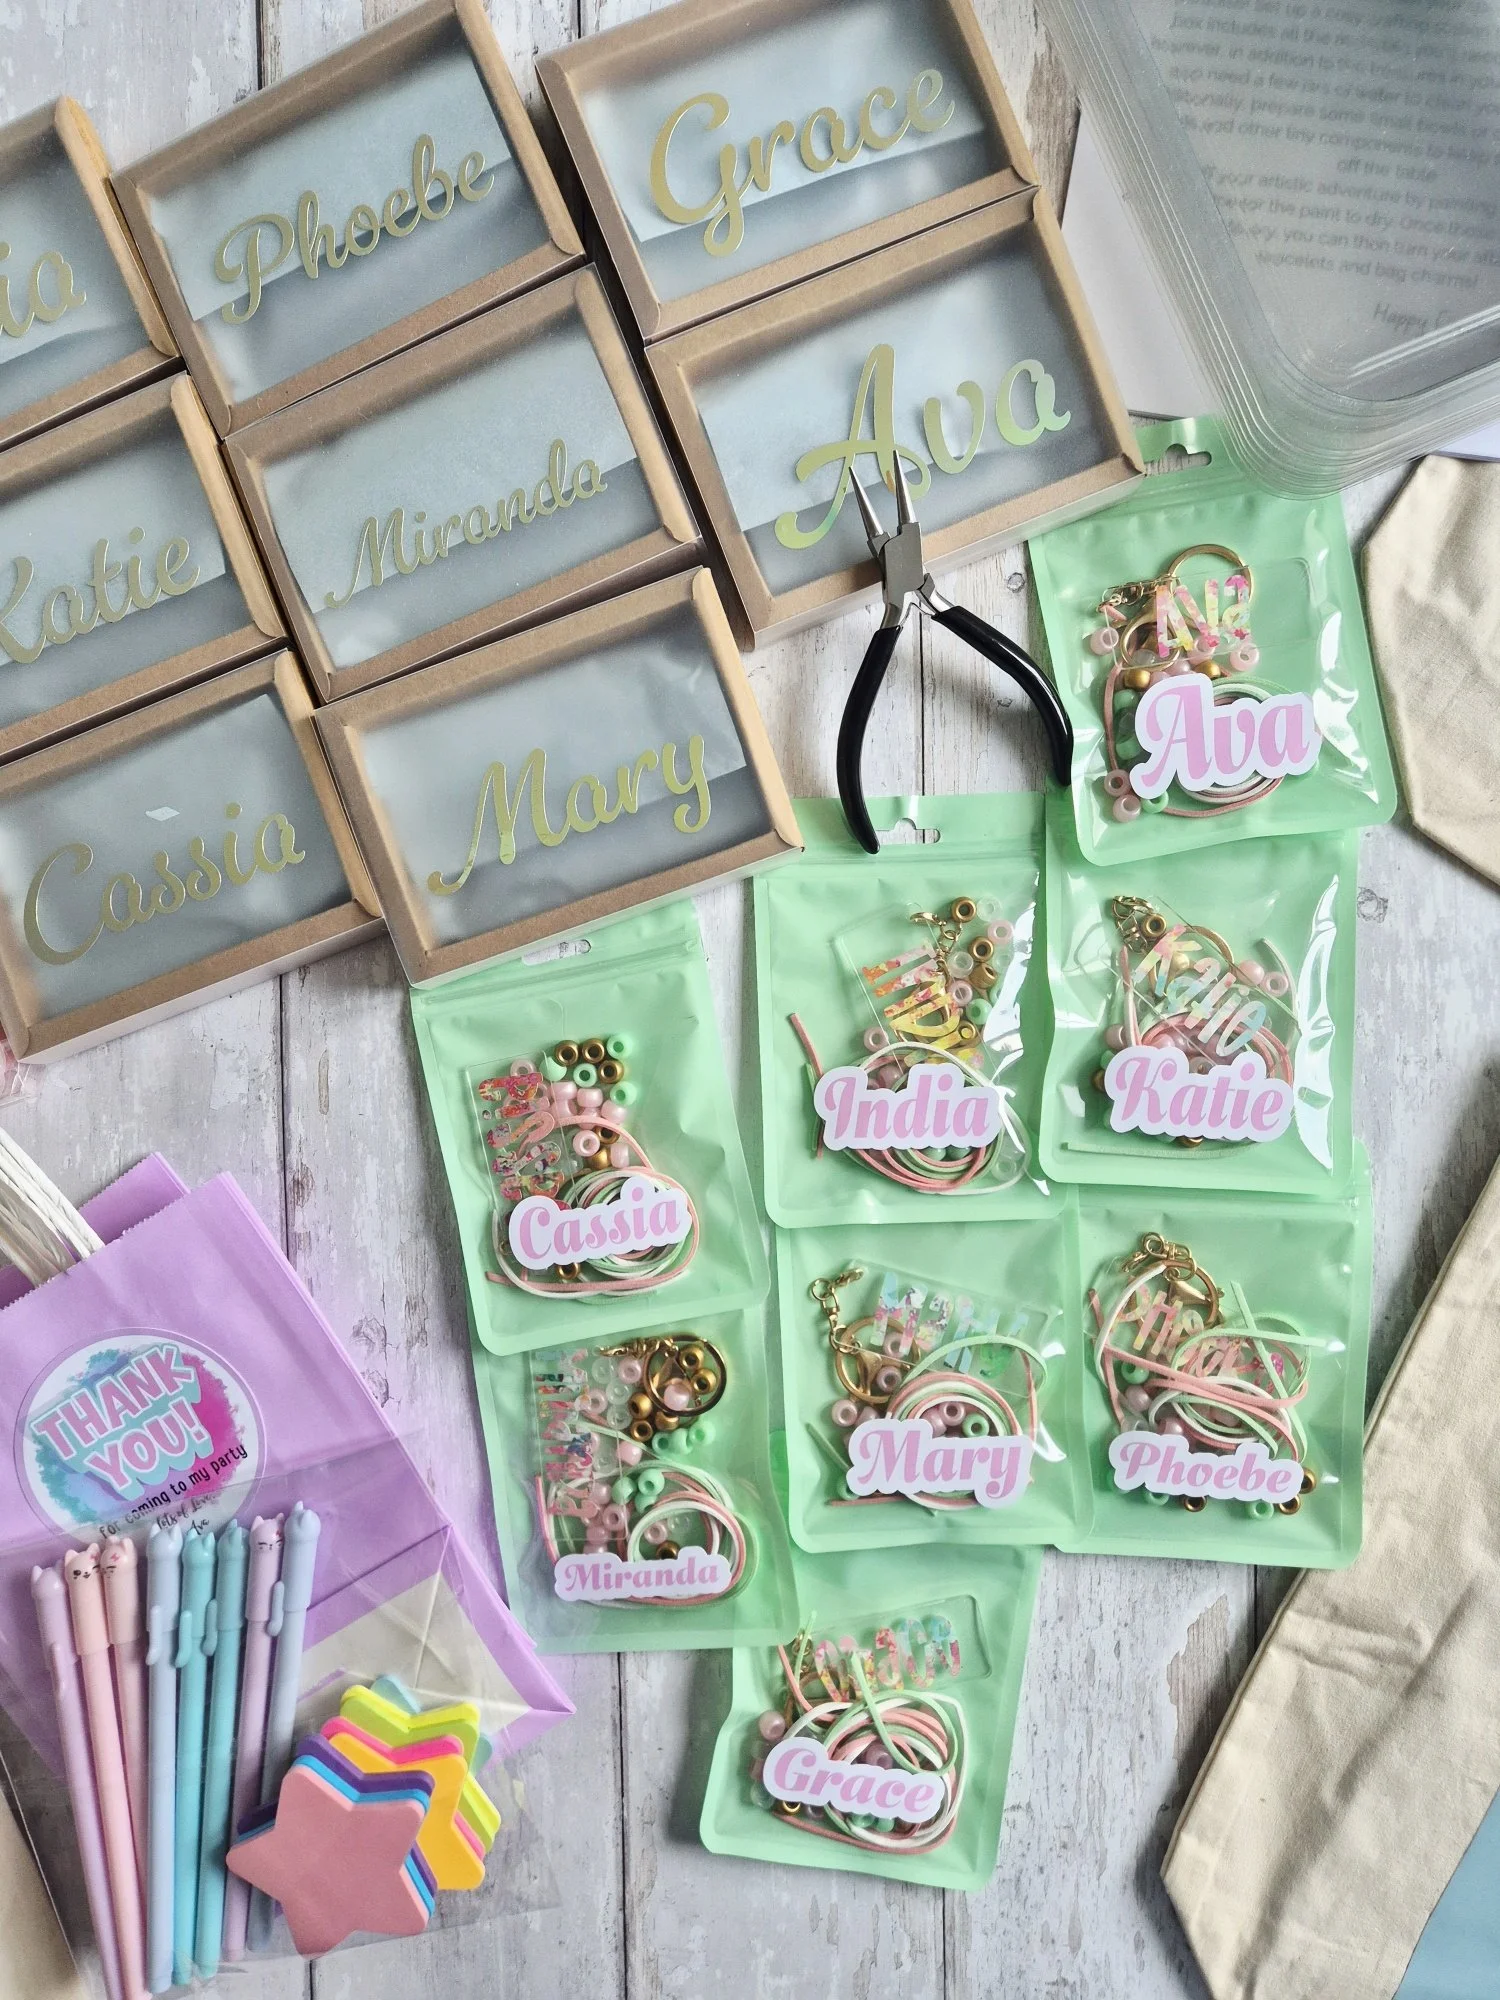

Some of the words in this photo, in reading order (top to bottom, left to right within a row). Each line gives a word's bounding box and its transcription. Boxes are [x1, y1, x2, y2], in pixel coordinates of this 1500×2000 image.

[649, 69, 956, 256] Grace
[214, 134, 495, 325] Phoebe
[774, 344, 1071, 549] Ava
[325, 437, 608, 609] Miranda
[1141, 685, 1311, 788] Ava
[428, 734, 713, 896] Mary
[24, 802, 306, 966] Cassia
[824, 1073, 991, 1140] India
[1116, 1056, 1285, 1132] Katie
[519, 1186, 681, 1260] Cassia
[31, 1345, 196, 1461] THANK
[84, 1397, 210, 1491] YOU!
[125, 1490, 171, 1524] coming
[170, 1480, 187, 1495] to
[188, 1466, 210, 1486] my
[210, 1444, 248, 1475] party
[857, 1429, 1022, 1499] Mary
[1119, 1441, 1293, 1494] Phoebe
[564, 1556, 721, 1593] Miranda
[773, 1746, 936, 1814] Grace
